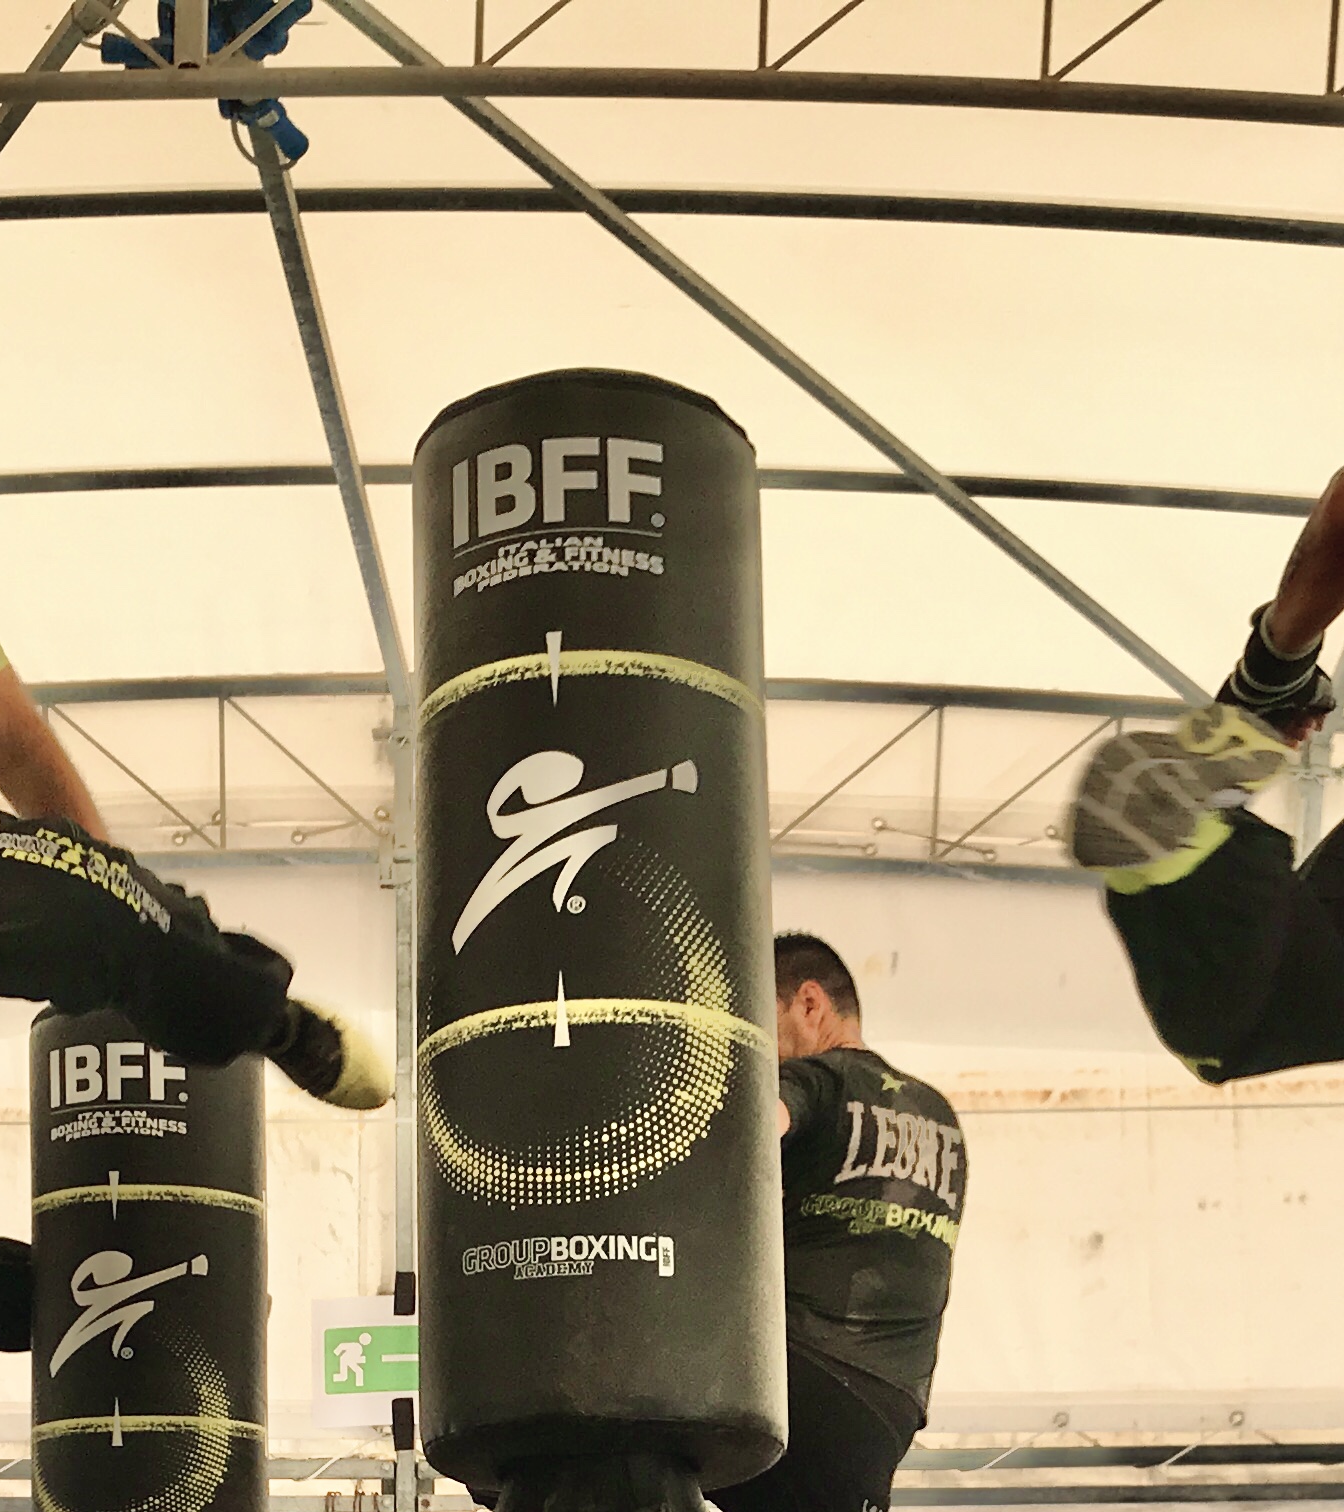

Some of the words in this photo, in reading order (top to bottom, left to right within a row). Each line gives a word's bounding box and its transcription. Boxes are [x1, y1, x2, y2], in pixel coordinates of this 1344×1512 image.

[498, 536, 604, 557] ITALIAN
[453, 551, 529, 598] BOXING
[533, 548, 556, 562] &
[564, 546, 665, 575] FITNESS
[477, 560, 629, 593] FEDERATION
[50, 1118, 98, 1142] BOXING
[121, 1116, 187, 1135] FITNESS
[833, 1101, 960, 1210] LEONE
[462, 1234, 657, 1276] GROUPBOXING
[513, 1261, 594, 1280] ACADEMY
